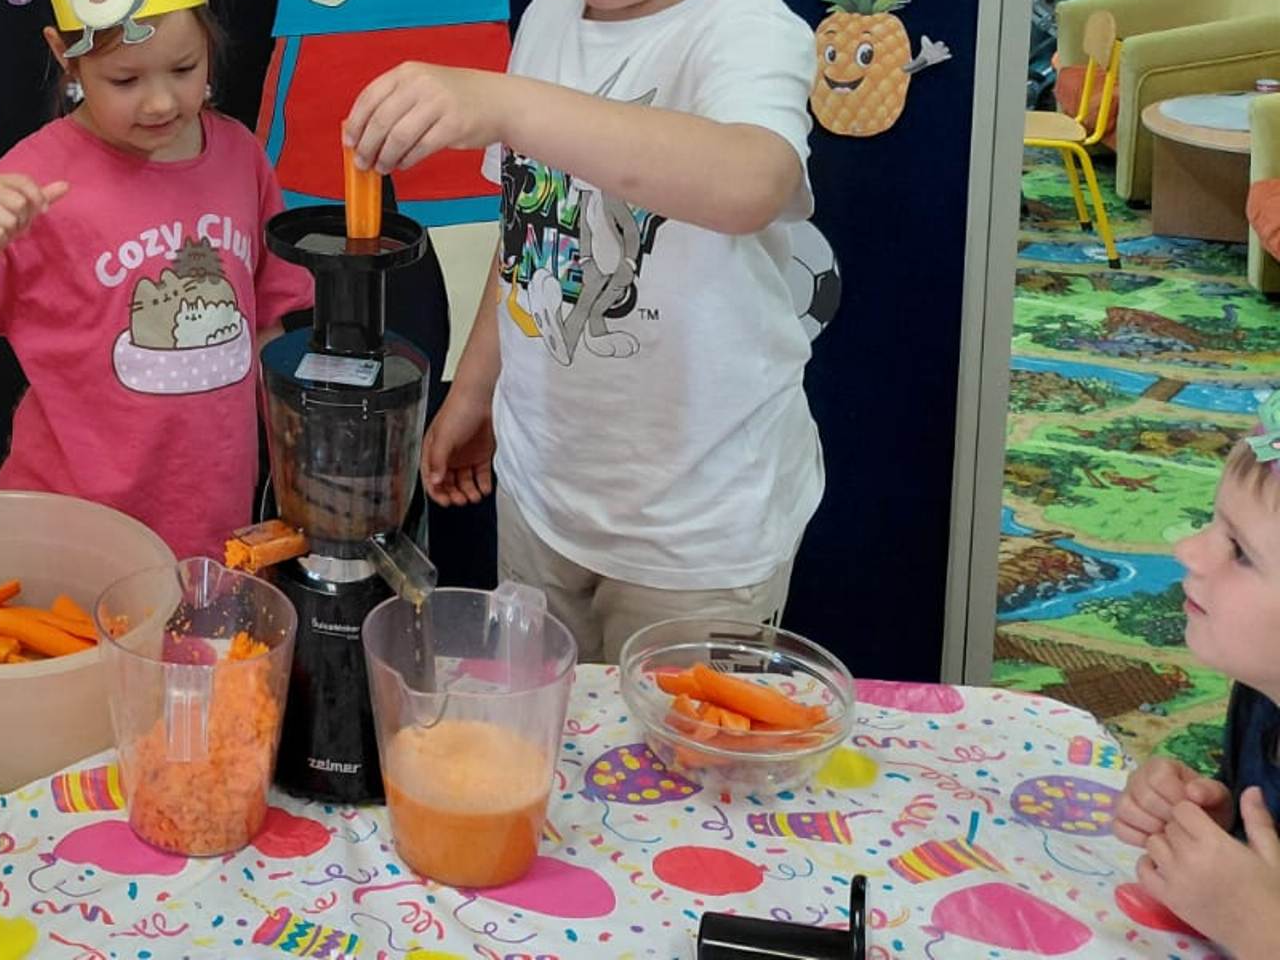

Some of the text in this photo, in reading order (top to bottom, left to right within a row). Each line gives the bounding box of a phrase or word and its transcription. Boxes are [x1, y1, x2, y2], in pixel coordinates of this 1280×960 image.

[95, 213, 253, 288] Cozy Clu
[638, 308, 660, 321] TM
[307, 757, 363, 774] zelmer
